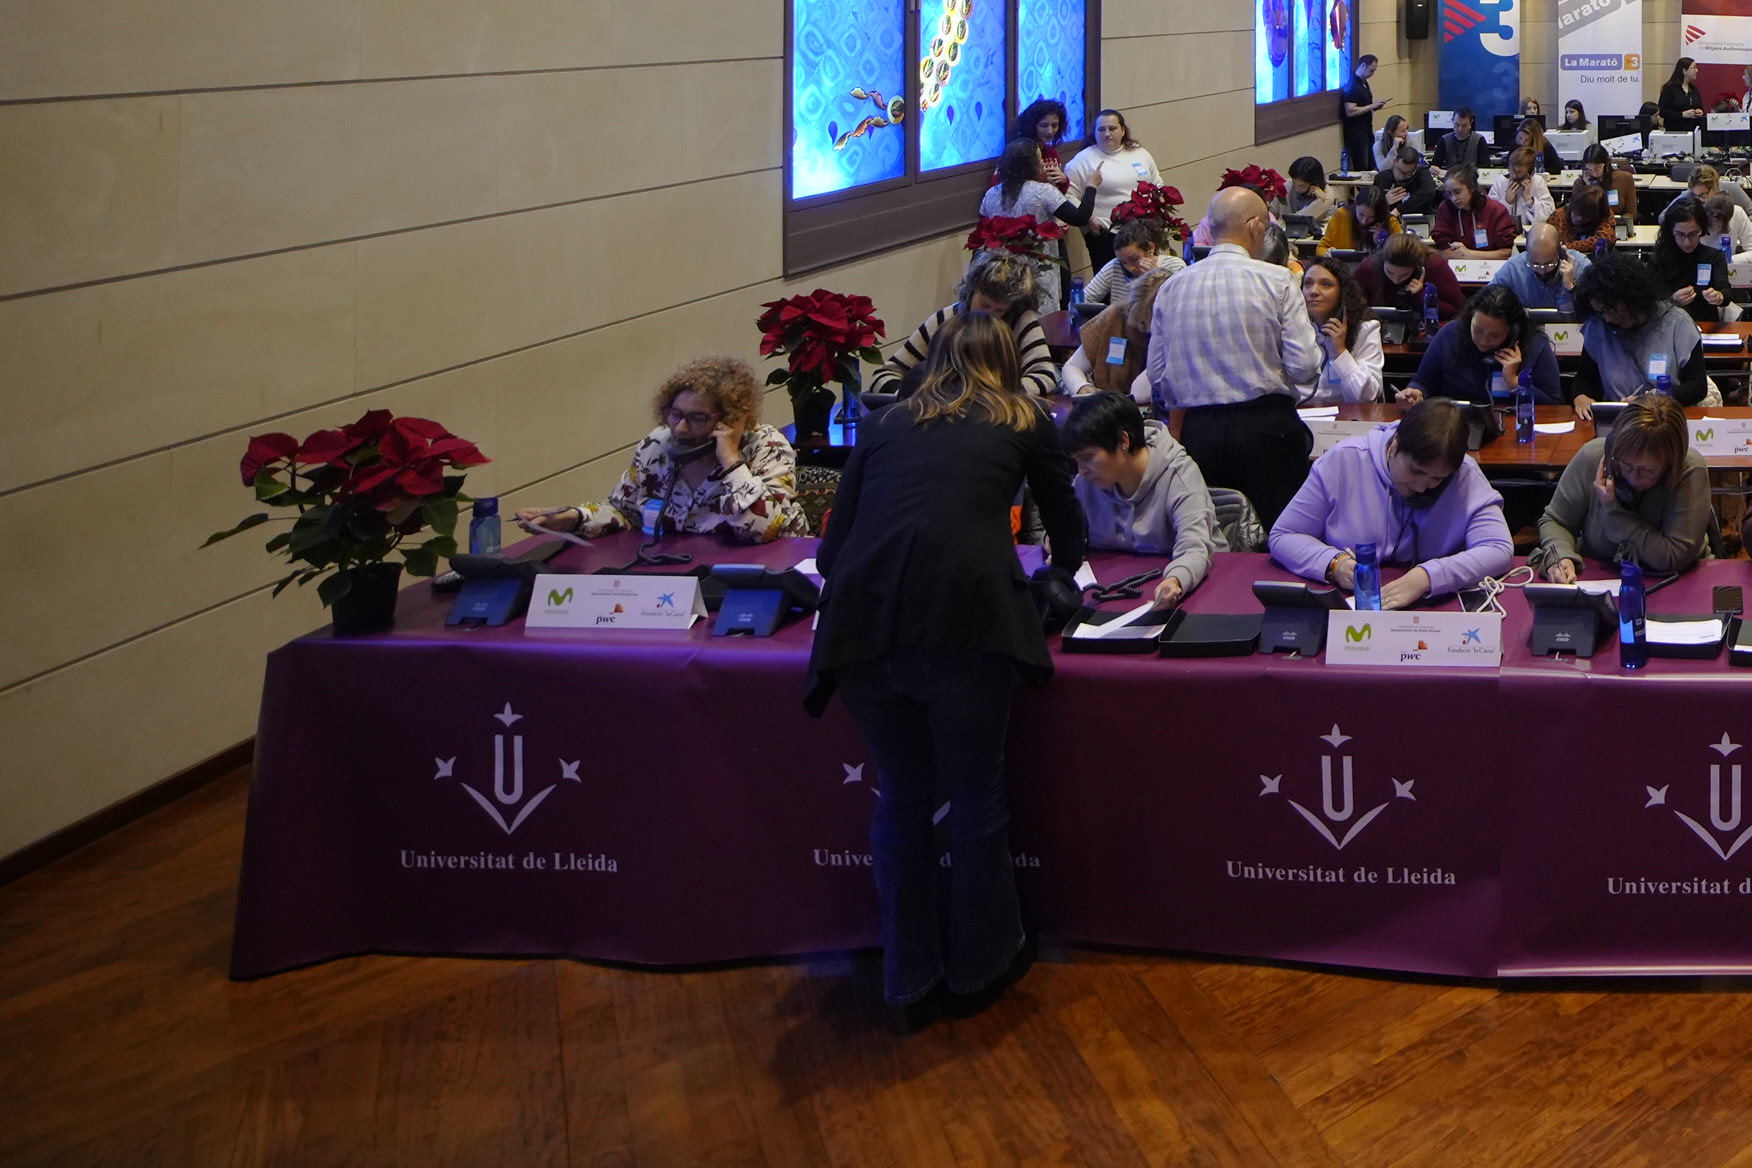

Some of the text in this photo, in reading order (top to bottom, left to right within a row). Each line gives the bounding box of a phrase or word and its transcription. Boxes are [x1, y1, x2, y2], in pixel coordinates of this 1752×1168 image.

[1565, 56, 1639, 68] La Marató 3
[1580, 75, 1595, 83] Diu
[1597, 75, 1615, 83] molt
[1618, 75, 1628, 83] de
[595, 616, 615, 625] pwc
[1400, 652, 1421, 662] pwc
[400, 850, 618, 873] Universitat de Lleida
[1226, 861, 1456, 885] Universitat de Lleida
[1607, 877, 1731, 894] Universitat
